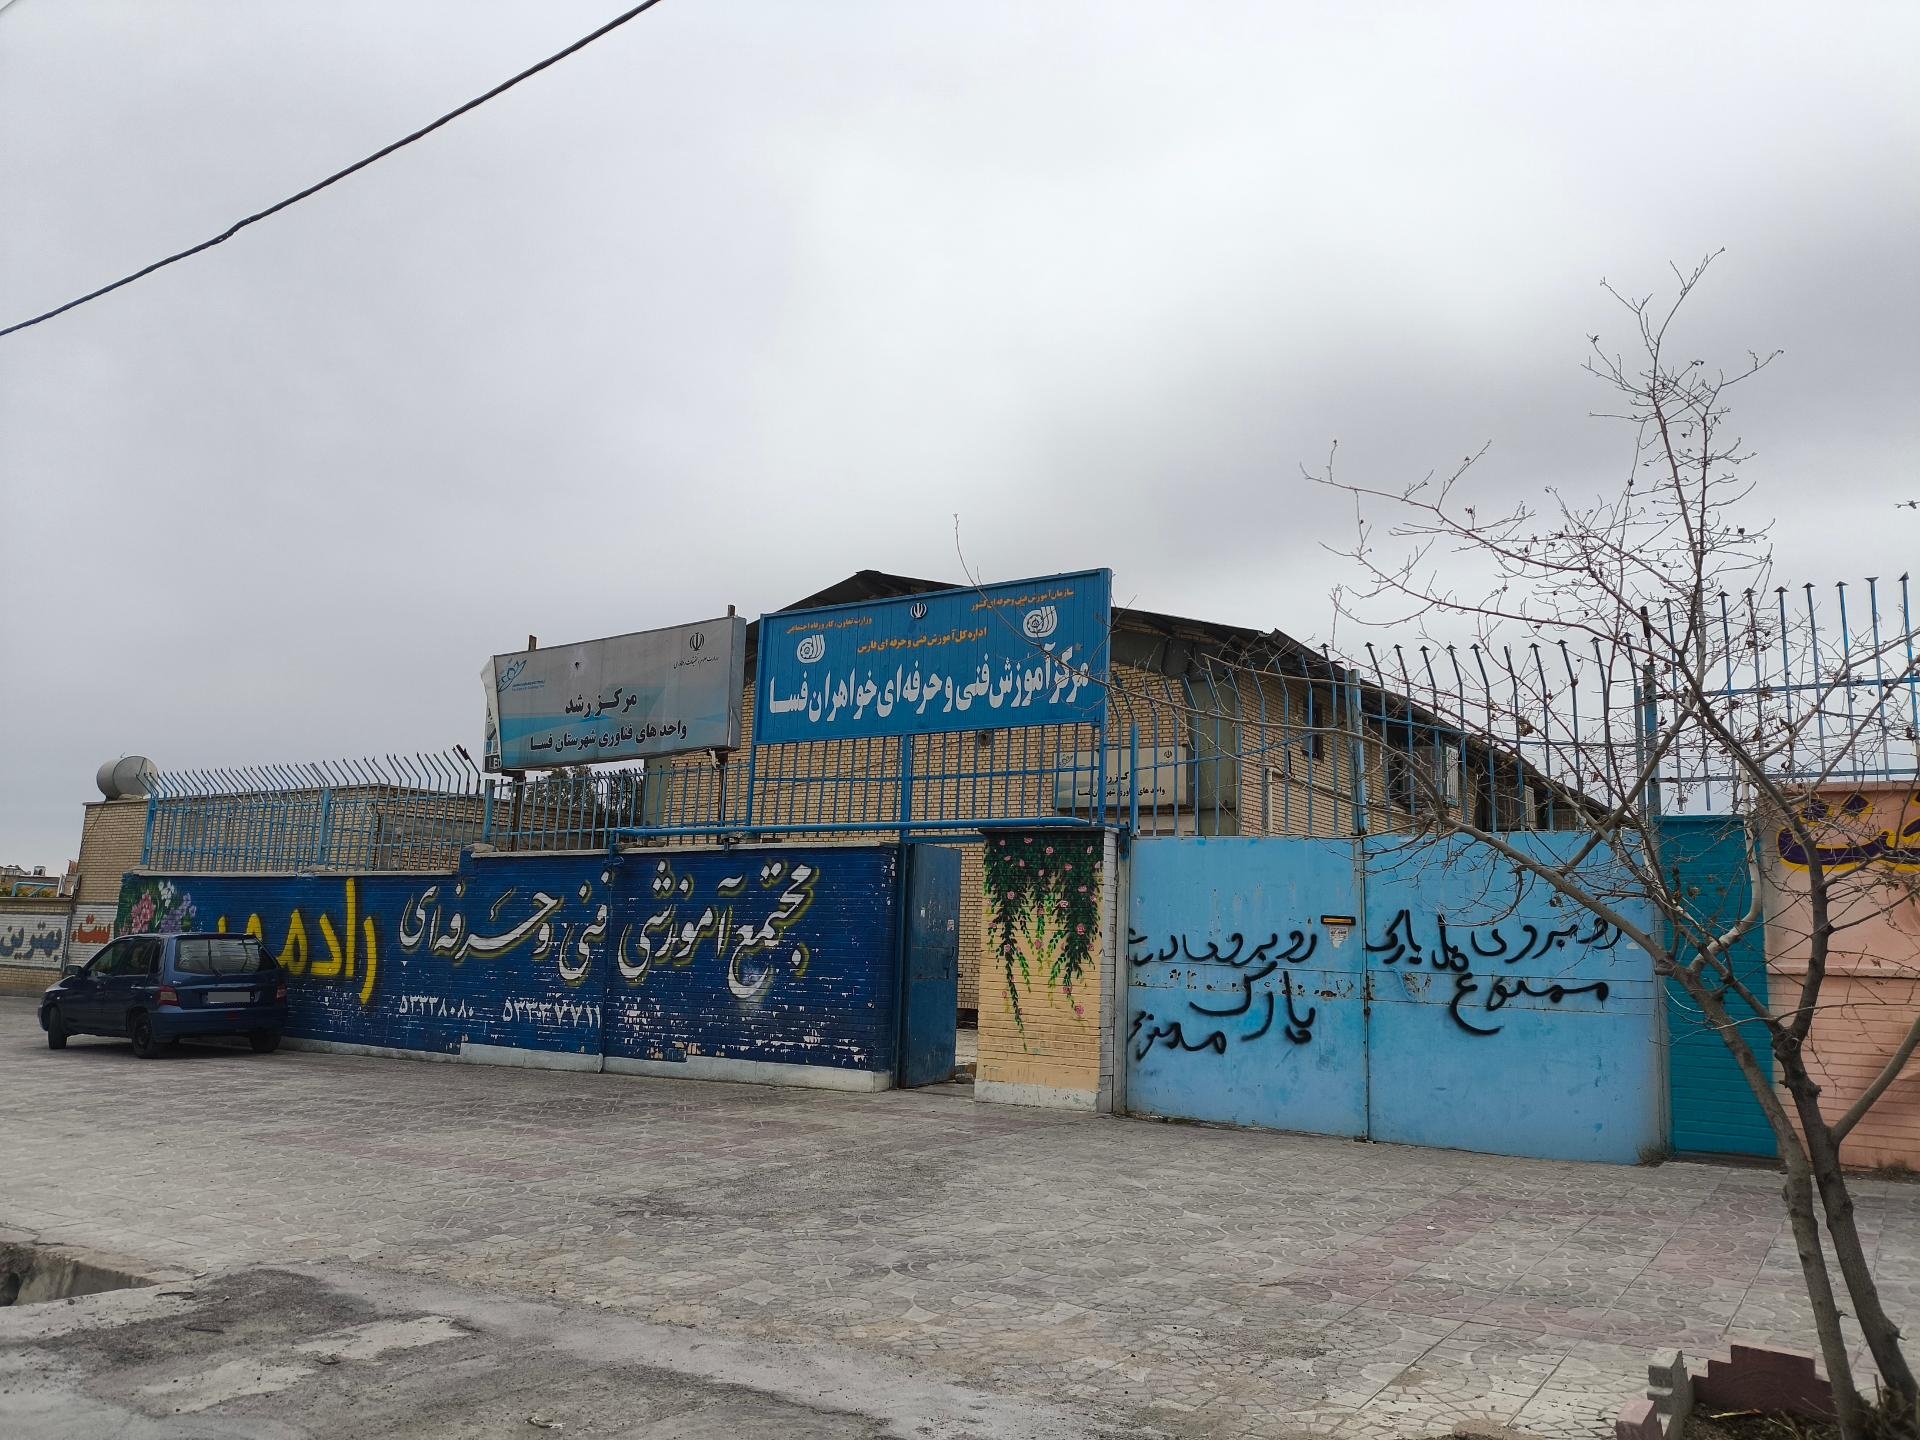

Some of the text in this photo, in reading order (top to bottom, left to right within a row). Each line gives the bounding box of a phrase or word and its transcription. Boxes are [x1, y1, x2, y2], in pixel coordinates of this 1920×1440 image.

[857, 639, 878, 653] فارس
[878, 638, 889, 650] ای
[890, 636, 907, 649] حرفه
[913, 635, 927, 647] فنی
[928, 628, 955, 646] آموزش
[955, 630, 968, 643] کل
[968, 626, 987, 641] اداره
[769, 642, 1089, 723] مرکز آموزش فنی و حرفه ای خواهران فسا
[565, 688, 637, 717] مرکز رشد
[530, 720, 687, 752] واحد های فناوری شهرستان فسا
[559, 870, 610, 980] فنی
[617, 859, 743, 979] آموزشی
[728, 862, 812, 998] مجتمع
[532, 922, 550, 954] و
[1188, 960, 1317, 1045] پارک
[1449, 971, 1610, 1036] ممنوع
